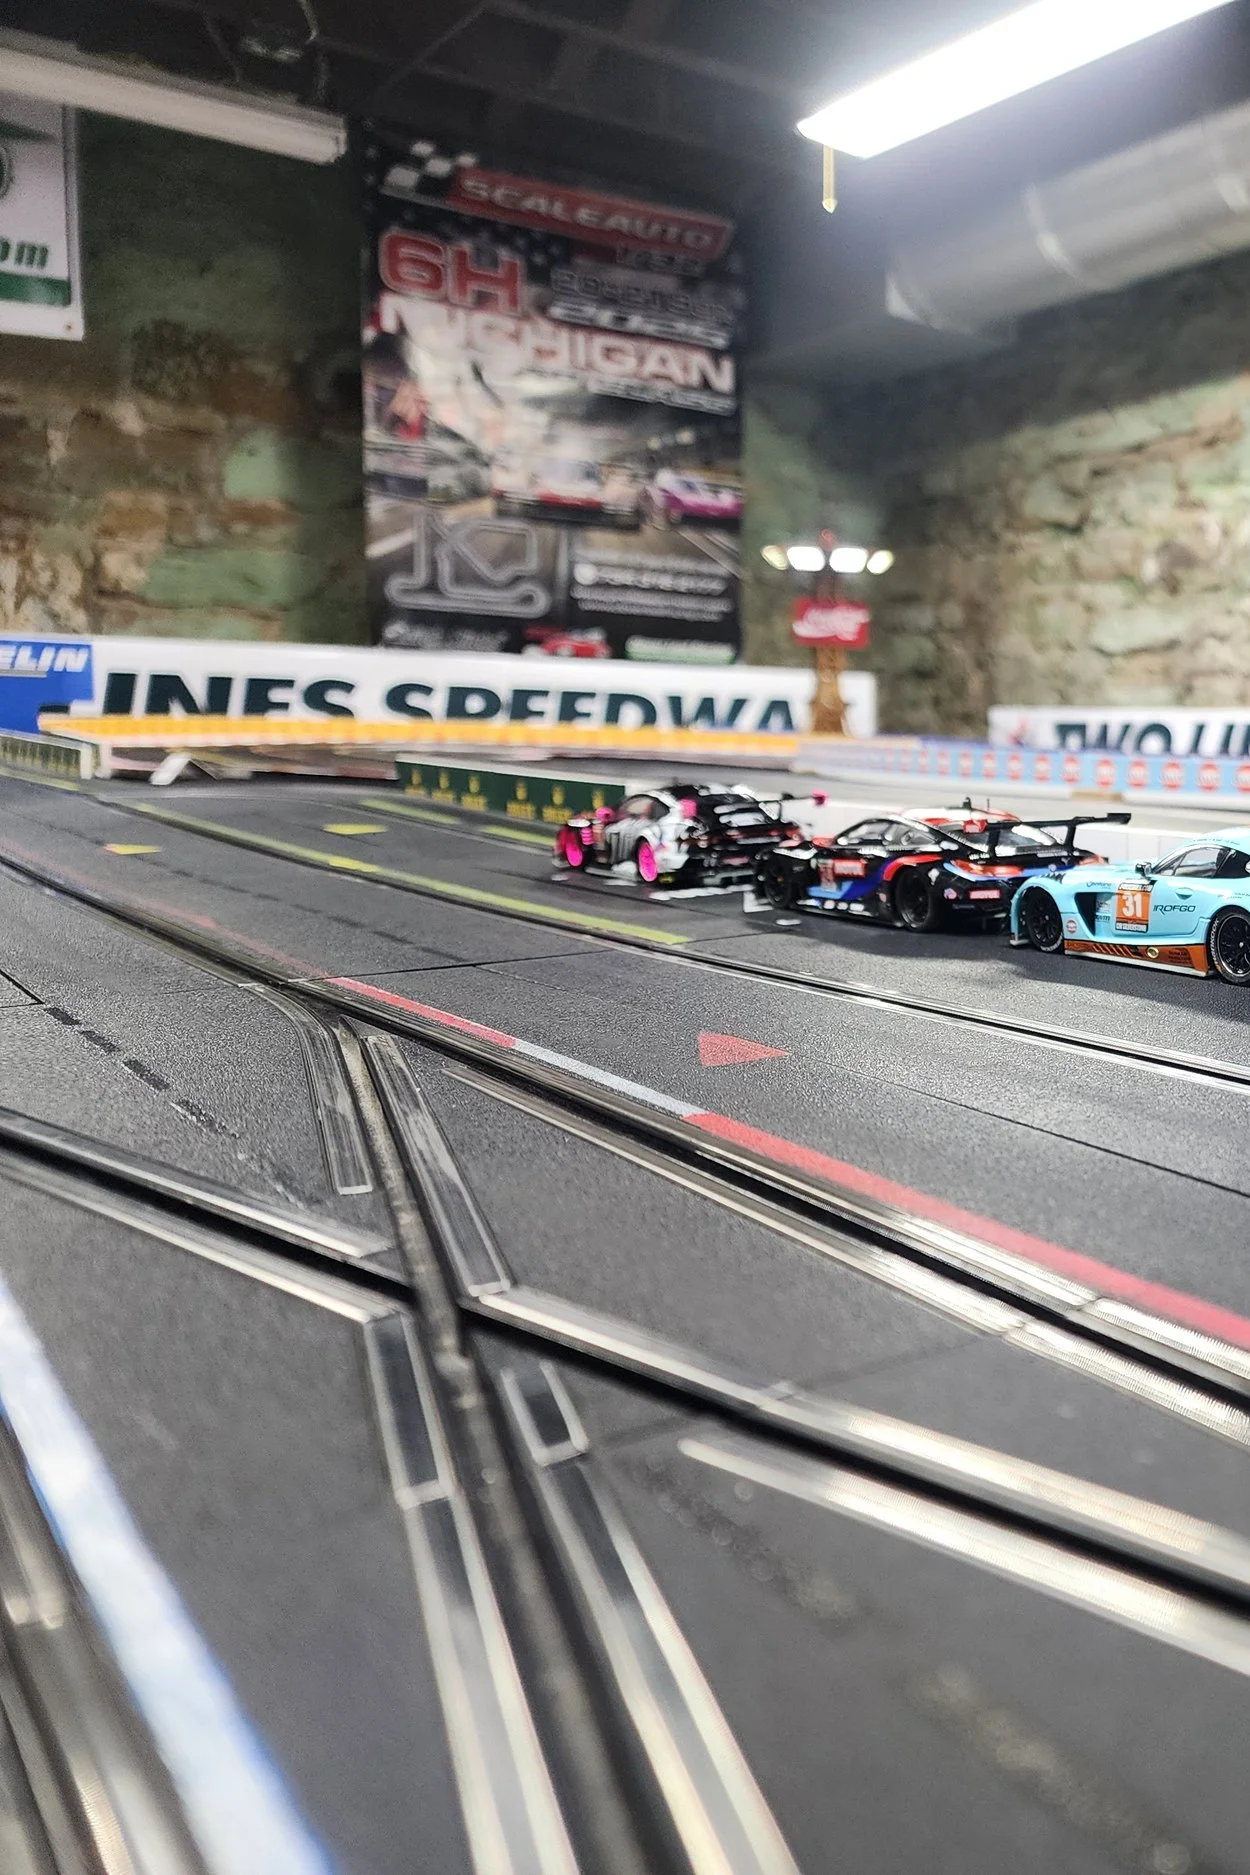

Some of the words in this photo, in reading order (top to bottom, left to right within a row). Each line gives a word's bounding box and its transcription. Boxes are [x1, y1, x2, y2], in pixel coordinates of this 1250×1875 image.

[463, 178, 716, 252] SCALEAUTO
[380, 228, 523, 316] 6H
[1121, 892, 1143, 918] 31
